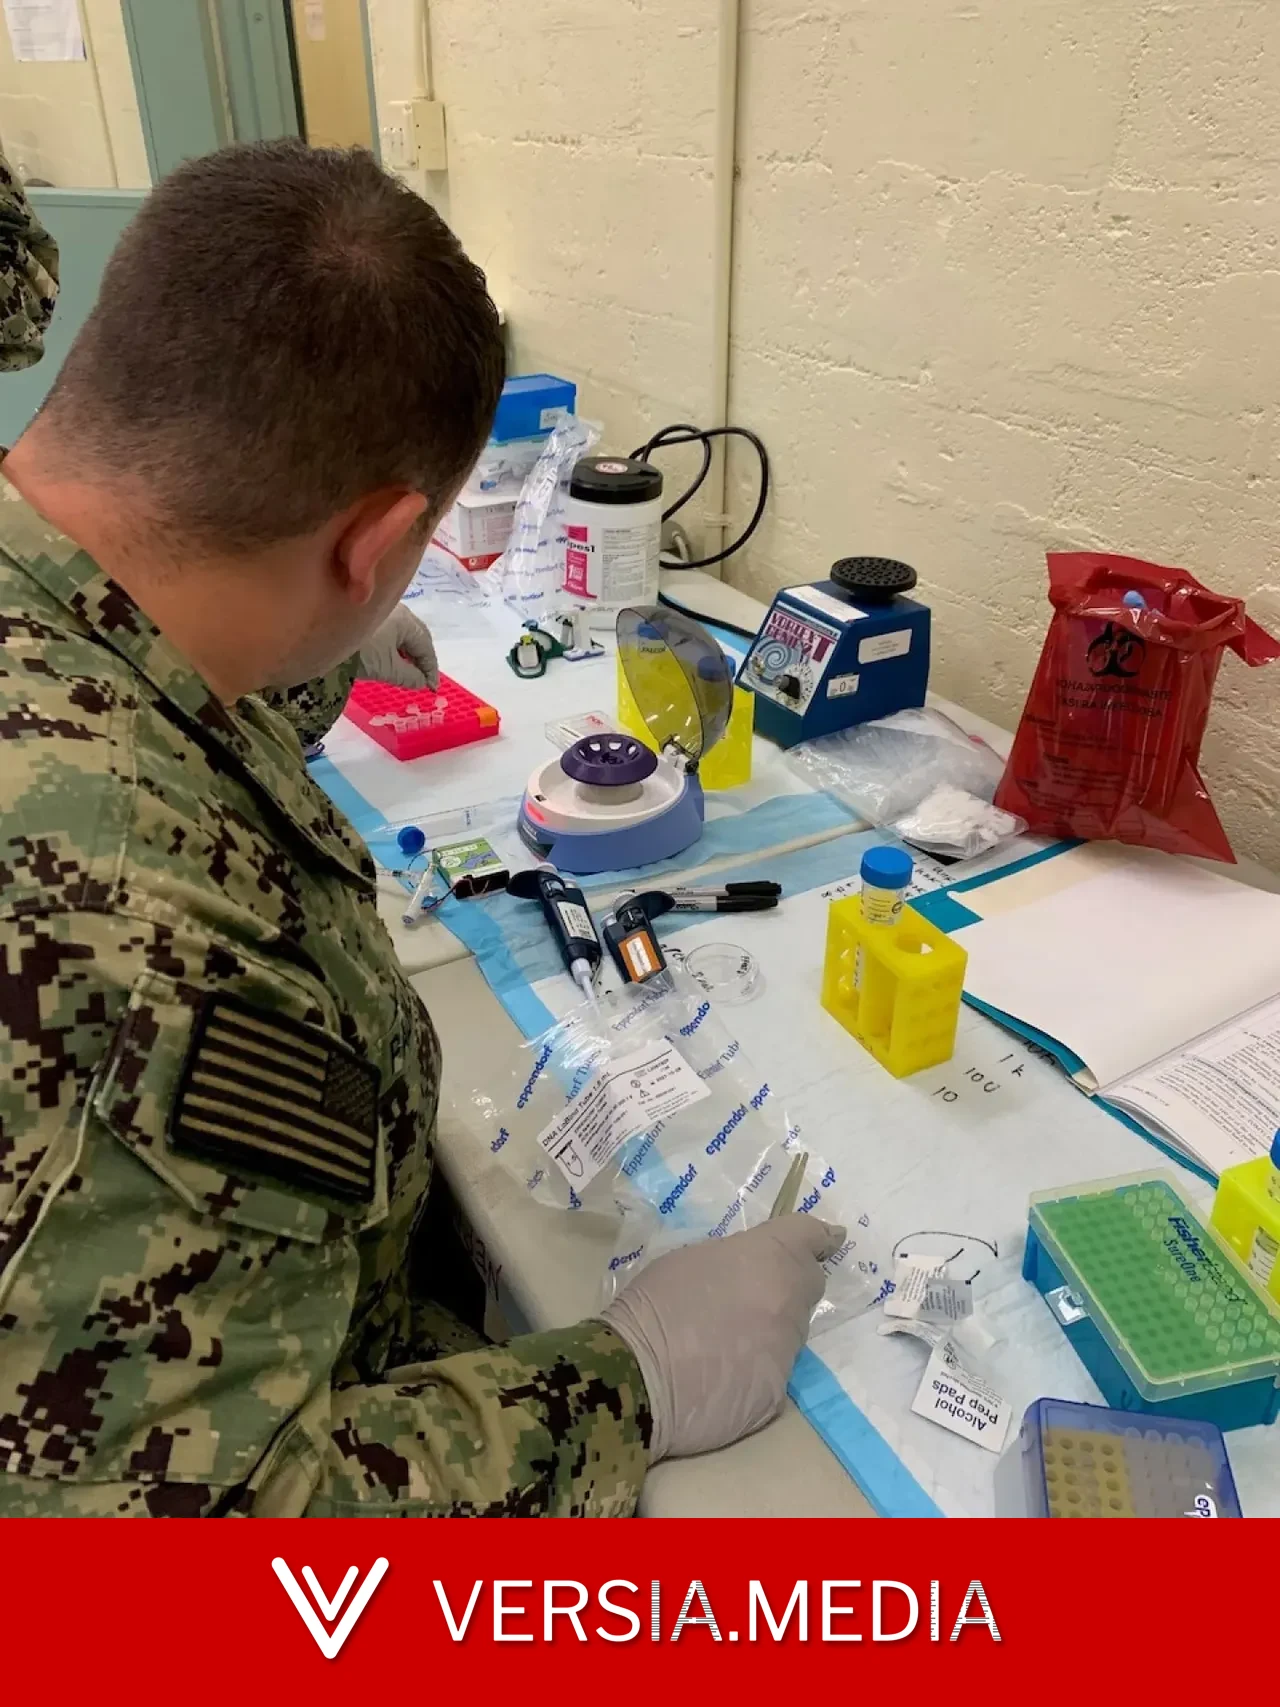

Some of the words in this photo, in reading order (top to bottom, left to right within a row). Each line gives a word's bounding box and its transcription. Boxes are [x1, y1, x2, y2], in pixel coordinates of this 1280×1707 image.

[516, 1045, 553, 1110] eppendorf
[931, 1086, 959, 1103] 10
[622, 1119, 667, 1178] Eppendorf
[659, 1162, 698, 1216] eppendorf
[932, 1378, 967, 1403] Pads
[934, 1397, 988, 1432] Alcohol
[968, 1397, 999, 1426] Prep
